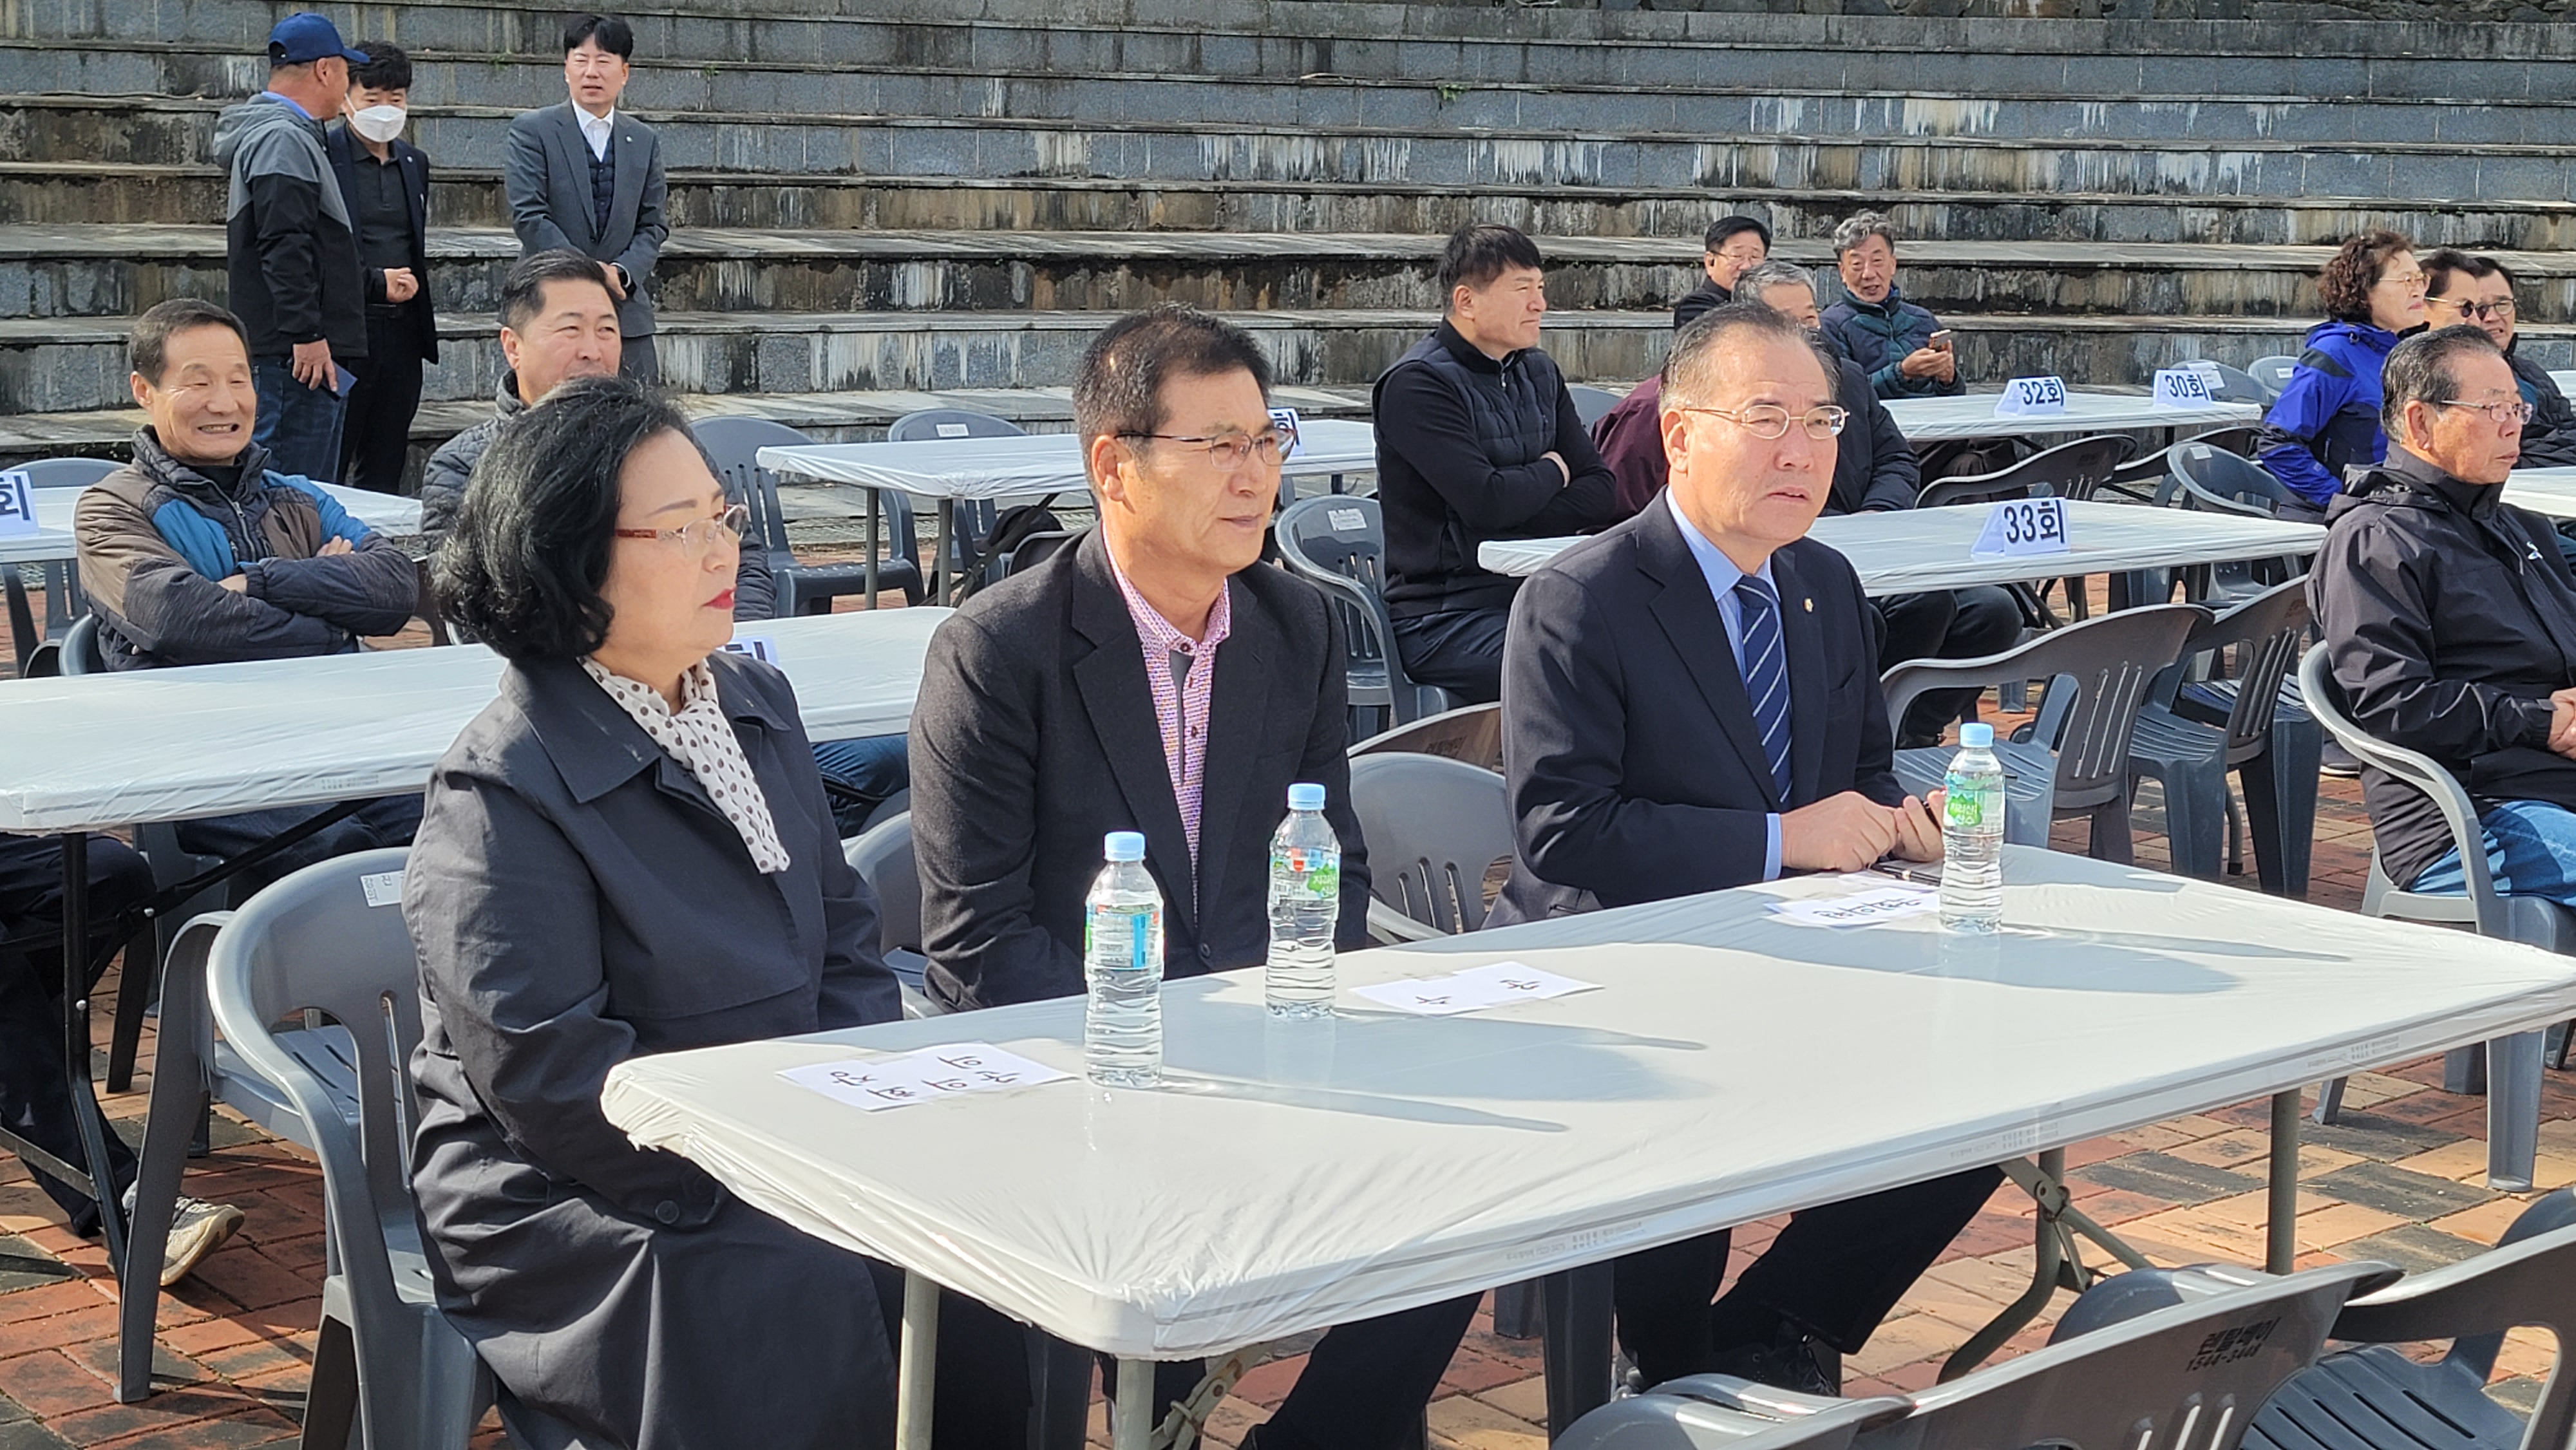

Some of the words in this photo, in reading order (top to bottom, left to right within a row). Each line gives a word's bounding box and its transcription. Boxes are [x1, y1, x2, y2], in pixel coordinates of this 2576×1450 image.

[2019, 379, 2064, 406] 32회
[2164, 374, 2210, 400] 30회
[2003, 500, 2065, 545] 33회
